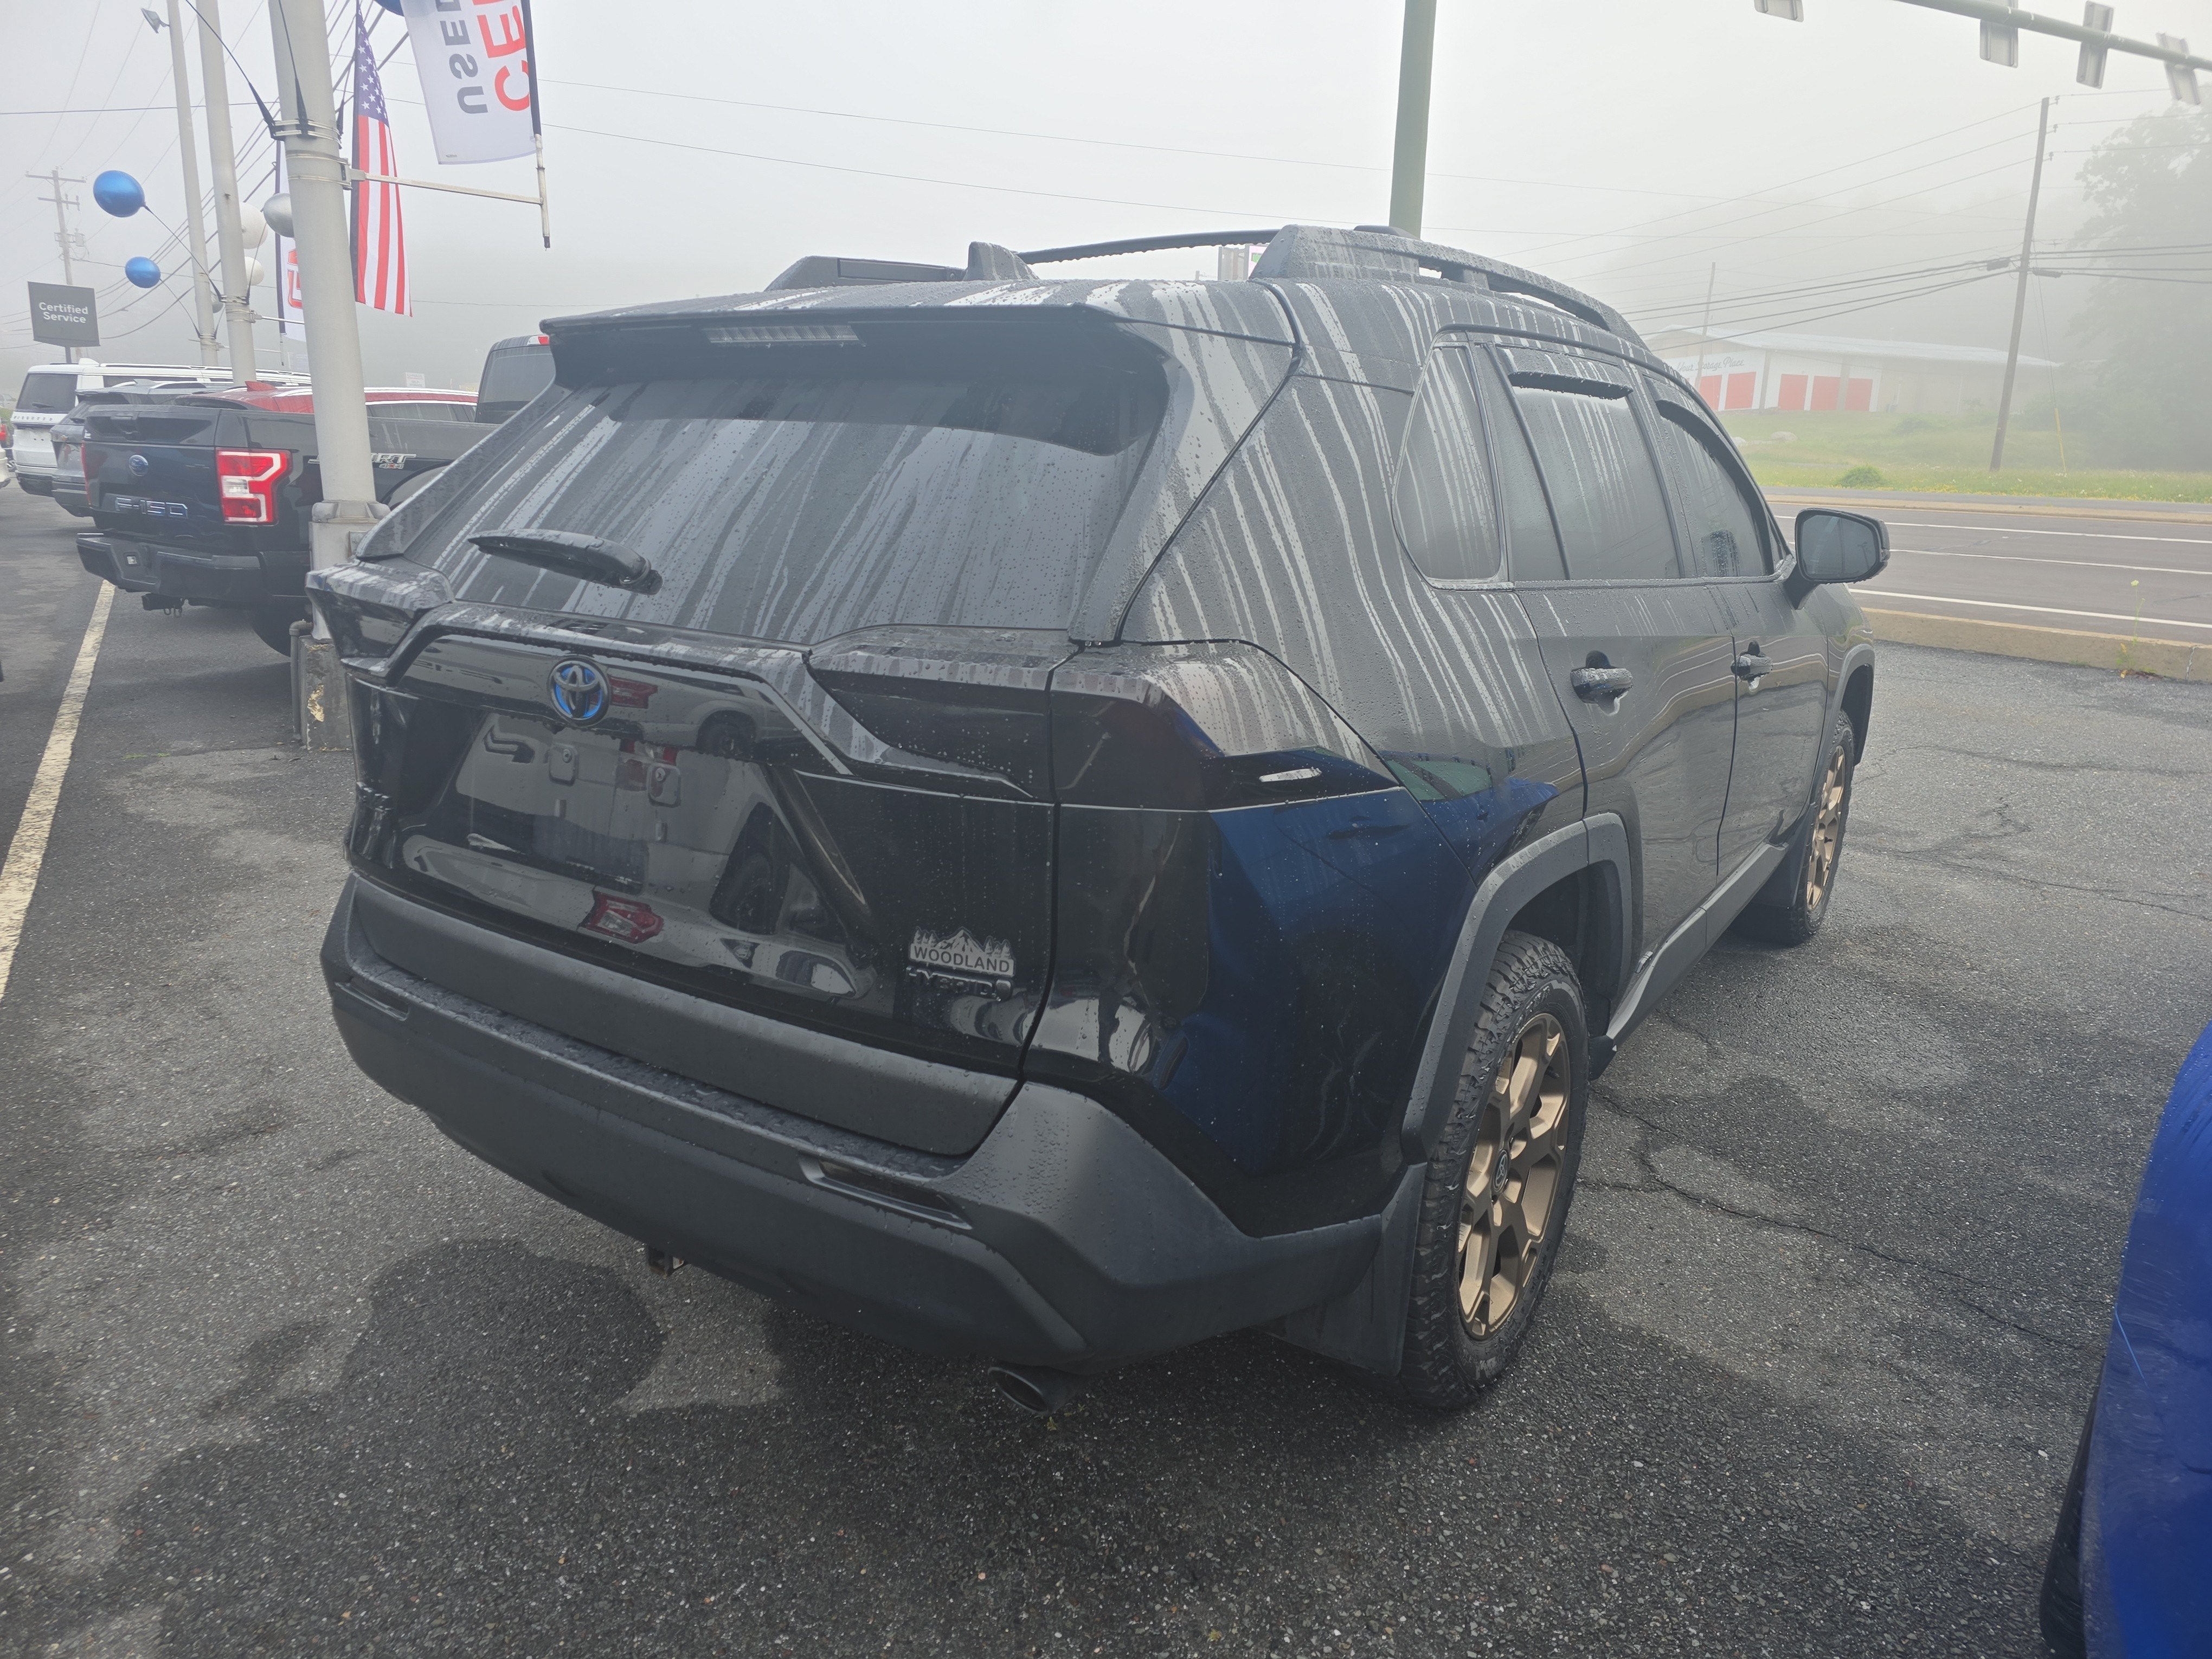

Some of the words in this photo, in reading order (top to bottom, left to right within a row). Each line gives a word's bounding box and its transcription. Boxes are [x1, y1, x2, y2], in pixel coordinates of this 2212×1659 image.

[38, 301, 88, 314] Certified
[43, 311, 86, 323] Service
[1723, 356, 1745, 368] Place
[114, 497, 188, 519] F-150
[914, 946, 1009, 973] WOODLAND
